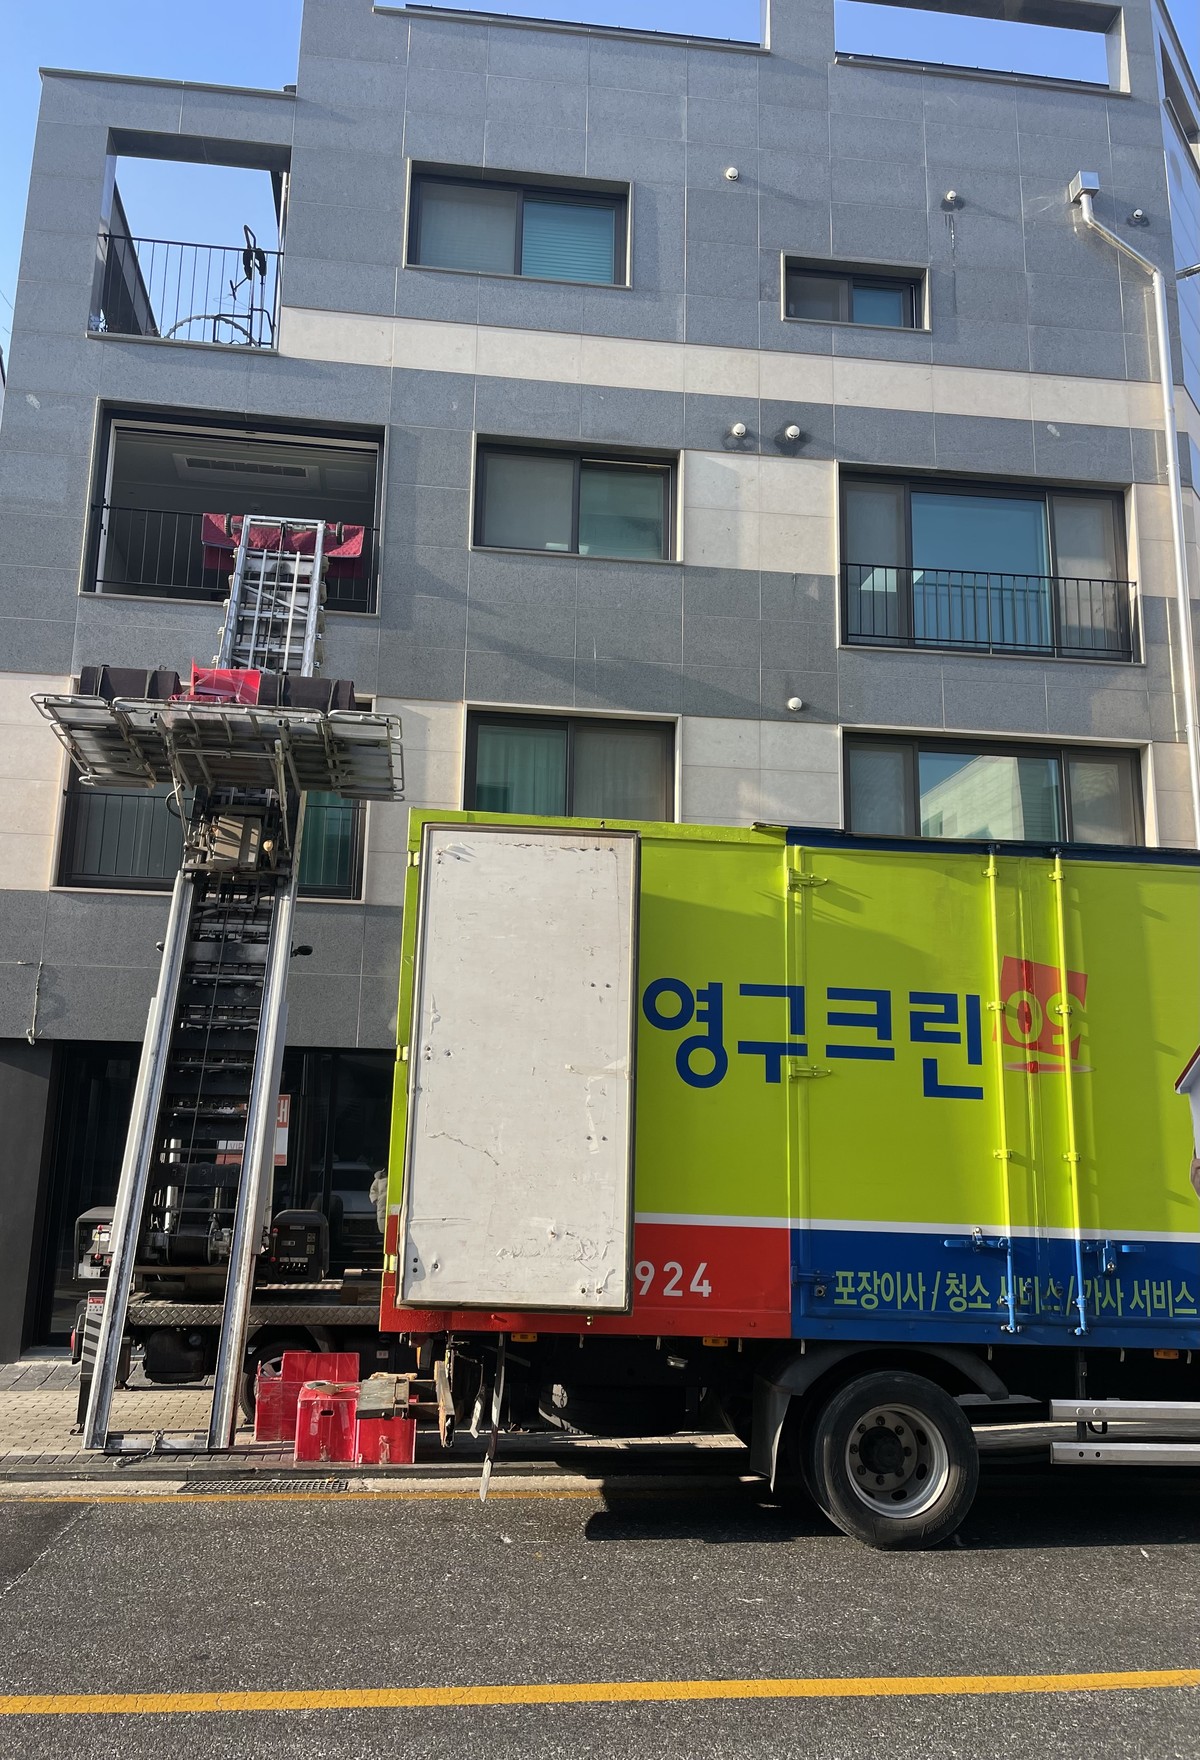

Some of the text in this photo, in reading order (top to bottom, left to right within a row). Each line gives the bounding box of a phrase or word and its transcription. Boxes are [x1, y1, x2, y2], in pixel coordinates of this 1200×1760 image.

[642, 978, 982, 1099] 영구크린
[634, 1260, 712, 1298] 924
[834, 1270, 926, 1311] 포장이사
[945, 1272, 991, 1313] 청소
[1129, 1279, 1198, 1318] 서비스
